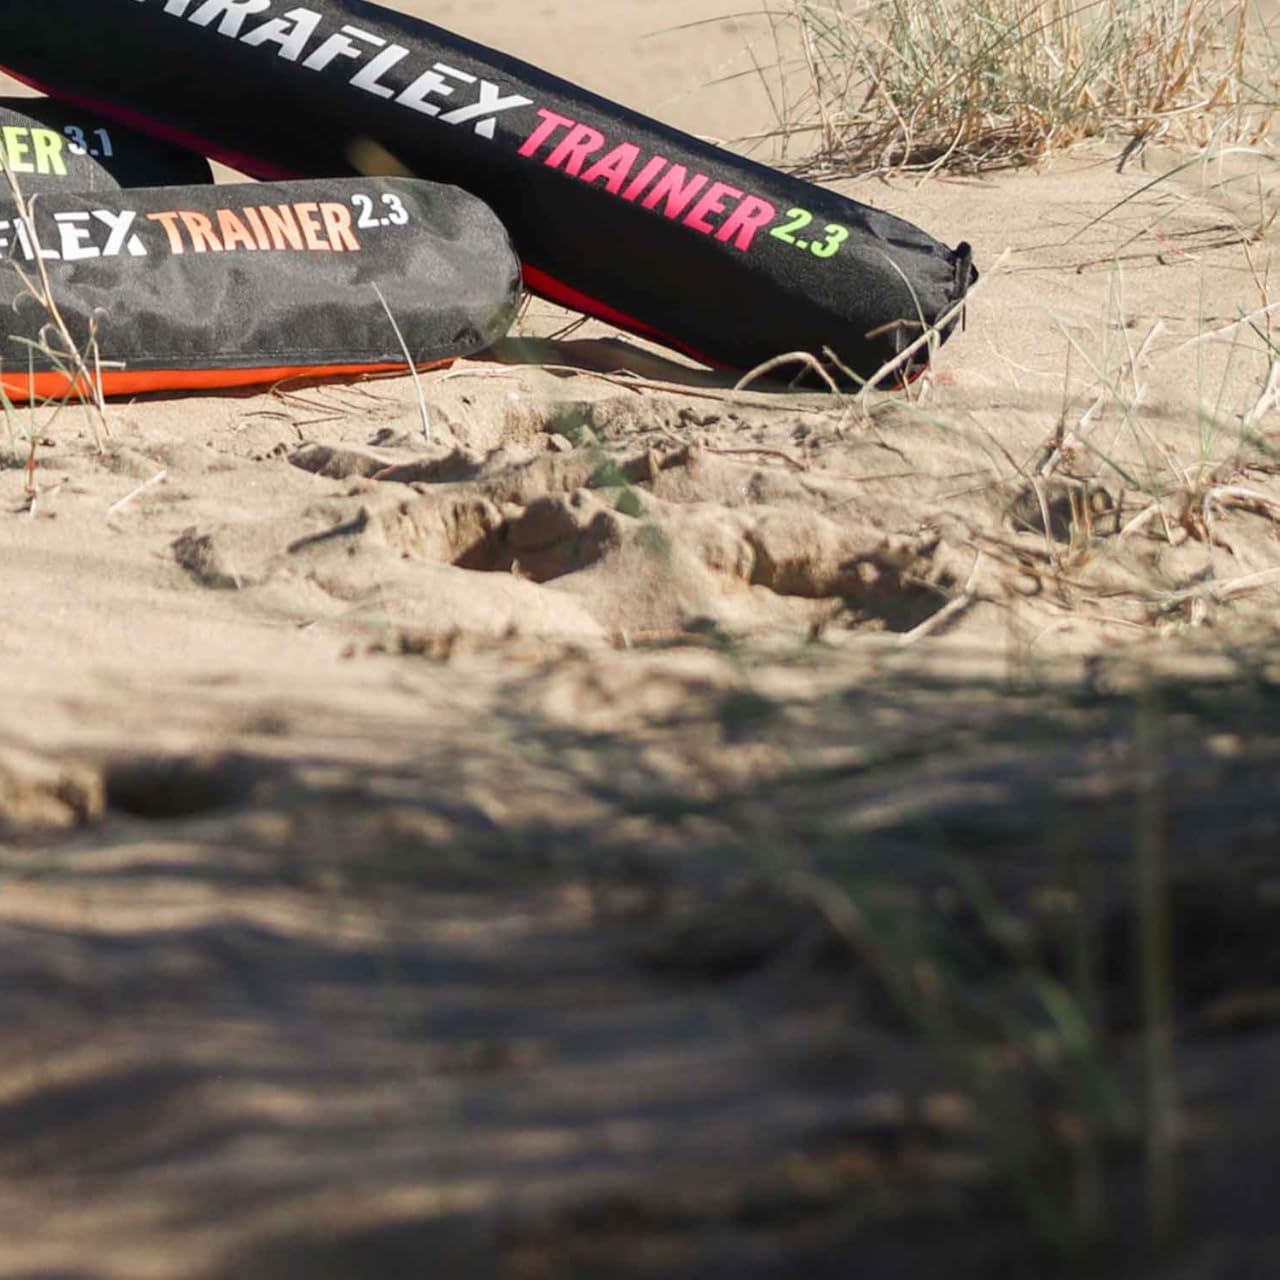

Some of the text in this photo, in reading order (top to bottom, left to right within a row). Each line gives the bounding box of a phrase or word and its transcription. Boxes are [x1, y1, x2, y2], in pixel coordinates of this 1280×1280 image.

[64, 125, 113, 157] 3.1
[518, 108, 776, 251] TRAINER
[770, 208, 849, 258] 2.3
[147, 202, 361, 254] TRAINER
[351, 194, 409, 229] 2.3
